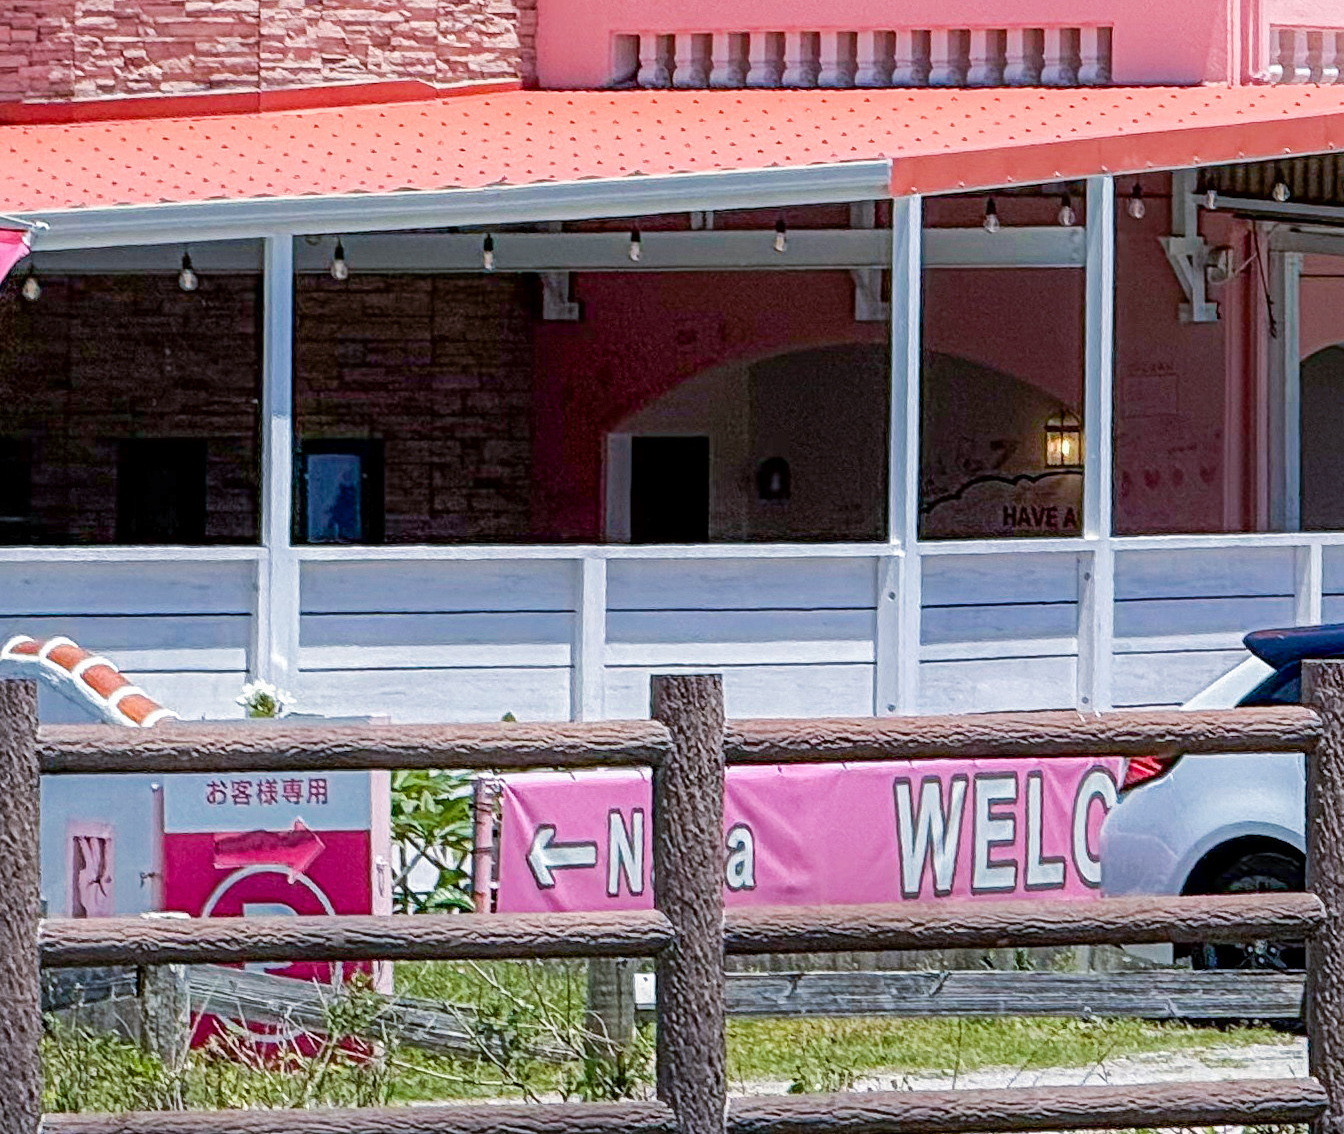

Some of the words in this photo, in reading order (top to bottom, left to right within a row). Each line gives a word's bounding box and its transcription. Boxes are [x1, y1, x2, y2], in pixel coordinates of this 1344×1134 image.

[1003, 506, 1058, 528] HAVE
[206, 778, 329, 805] お客様専用
